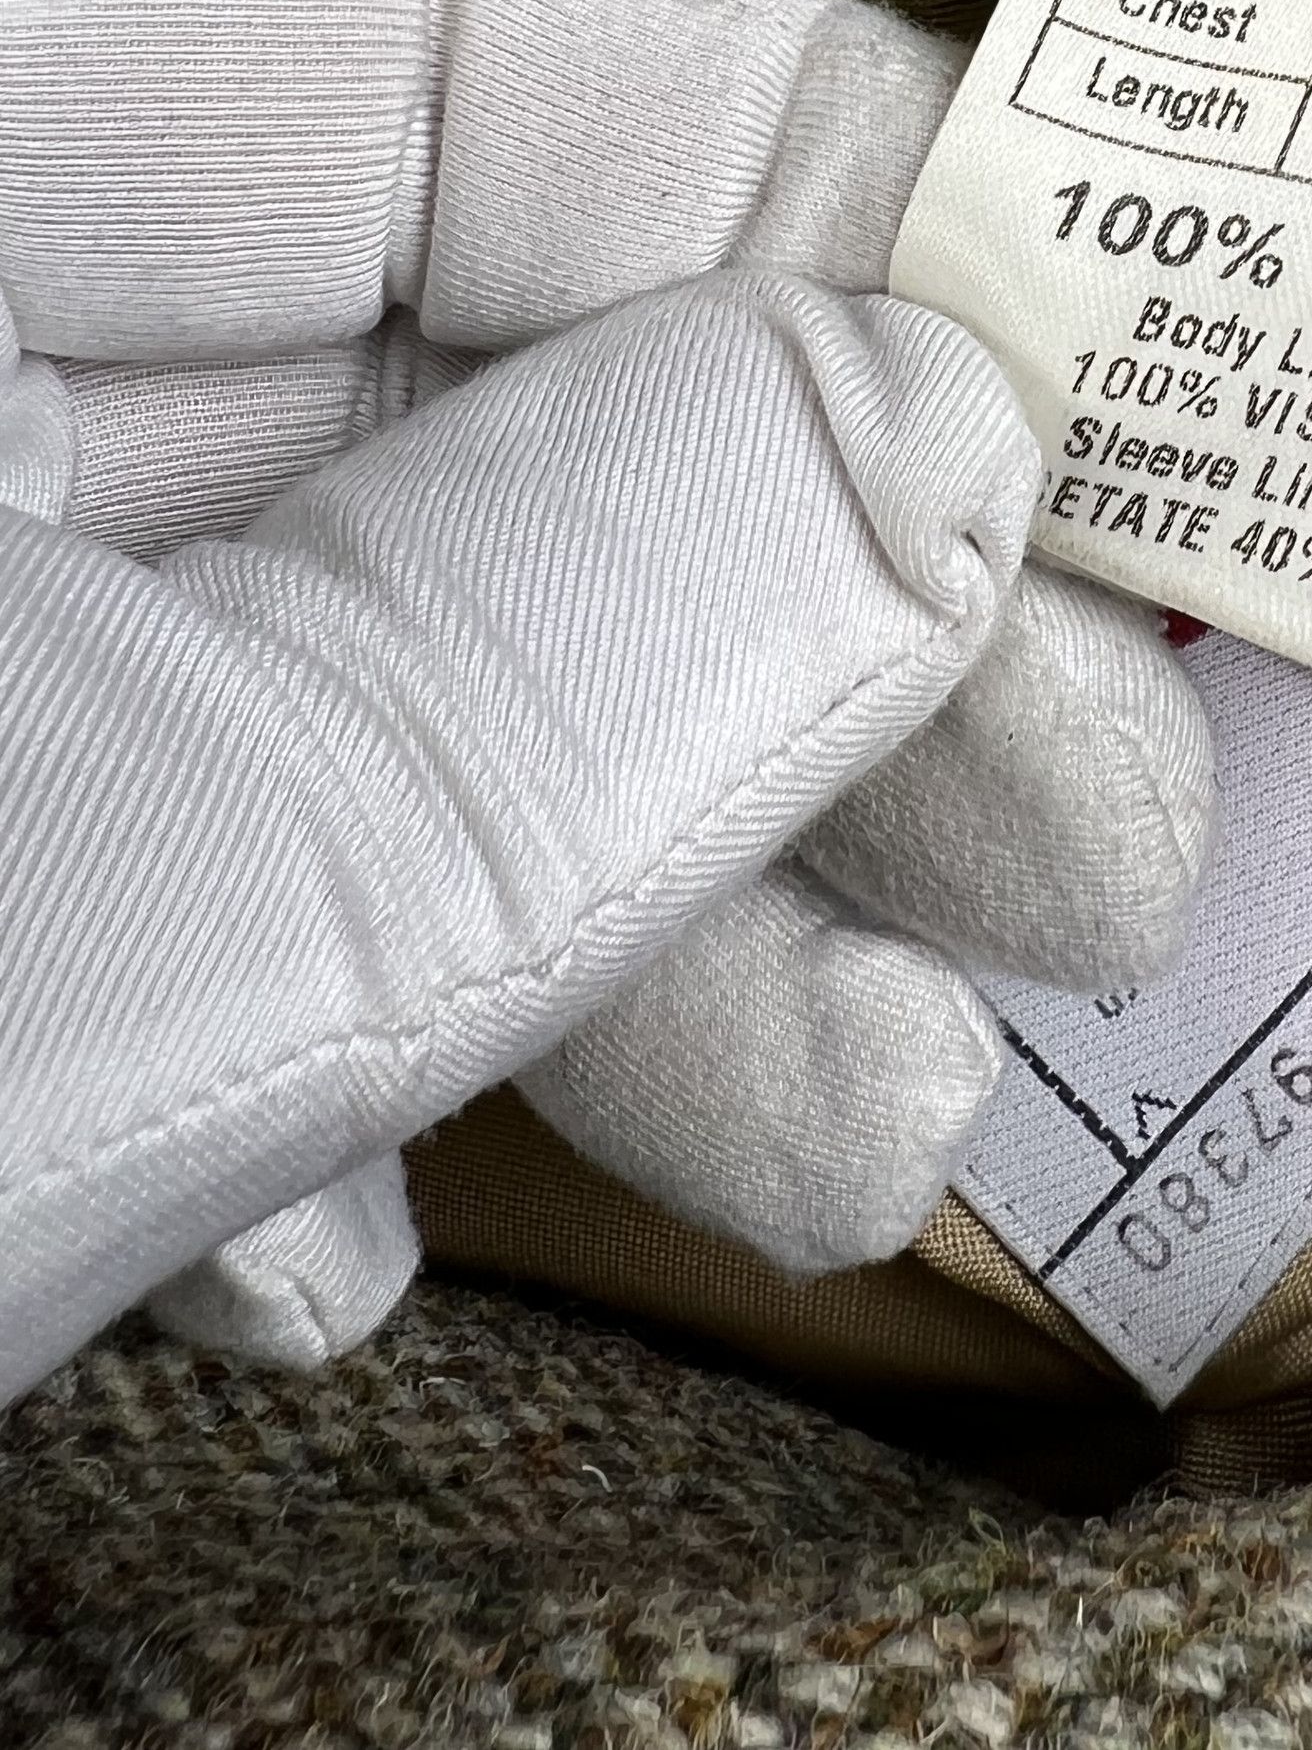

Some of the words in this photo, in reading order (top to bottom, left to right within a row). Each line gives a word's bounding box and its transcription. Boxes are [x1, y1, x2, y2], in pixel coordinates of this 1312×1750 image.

[1085, 56, 1250, 133] Length
[1054, 180, 1286, 289] 100%
[1132, 294, 1267, 372] Body
[1071, 350, 1222, 419] 100%
[1062, 415, 1240, 491] Sleeve
[1038, 471, 1220, 554] ETATE
